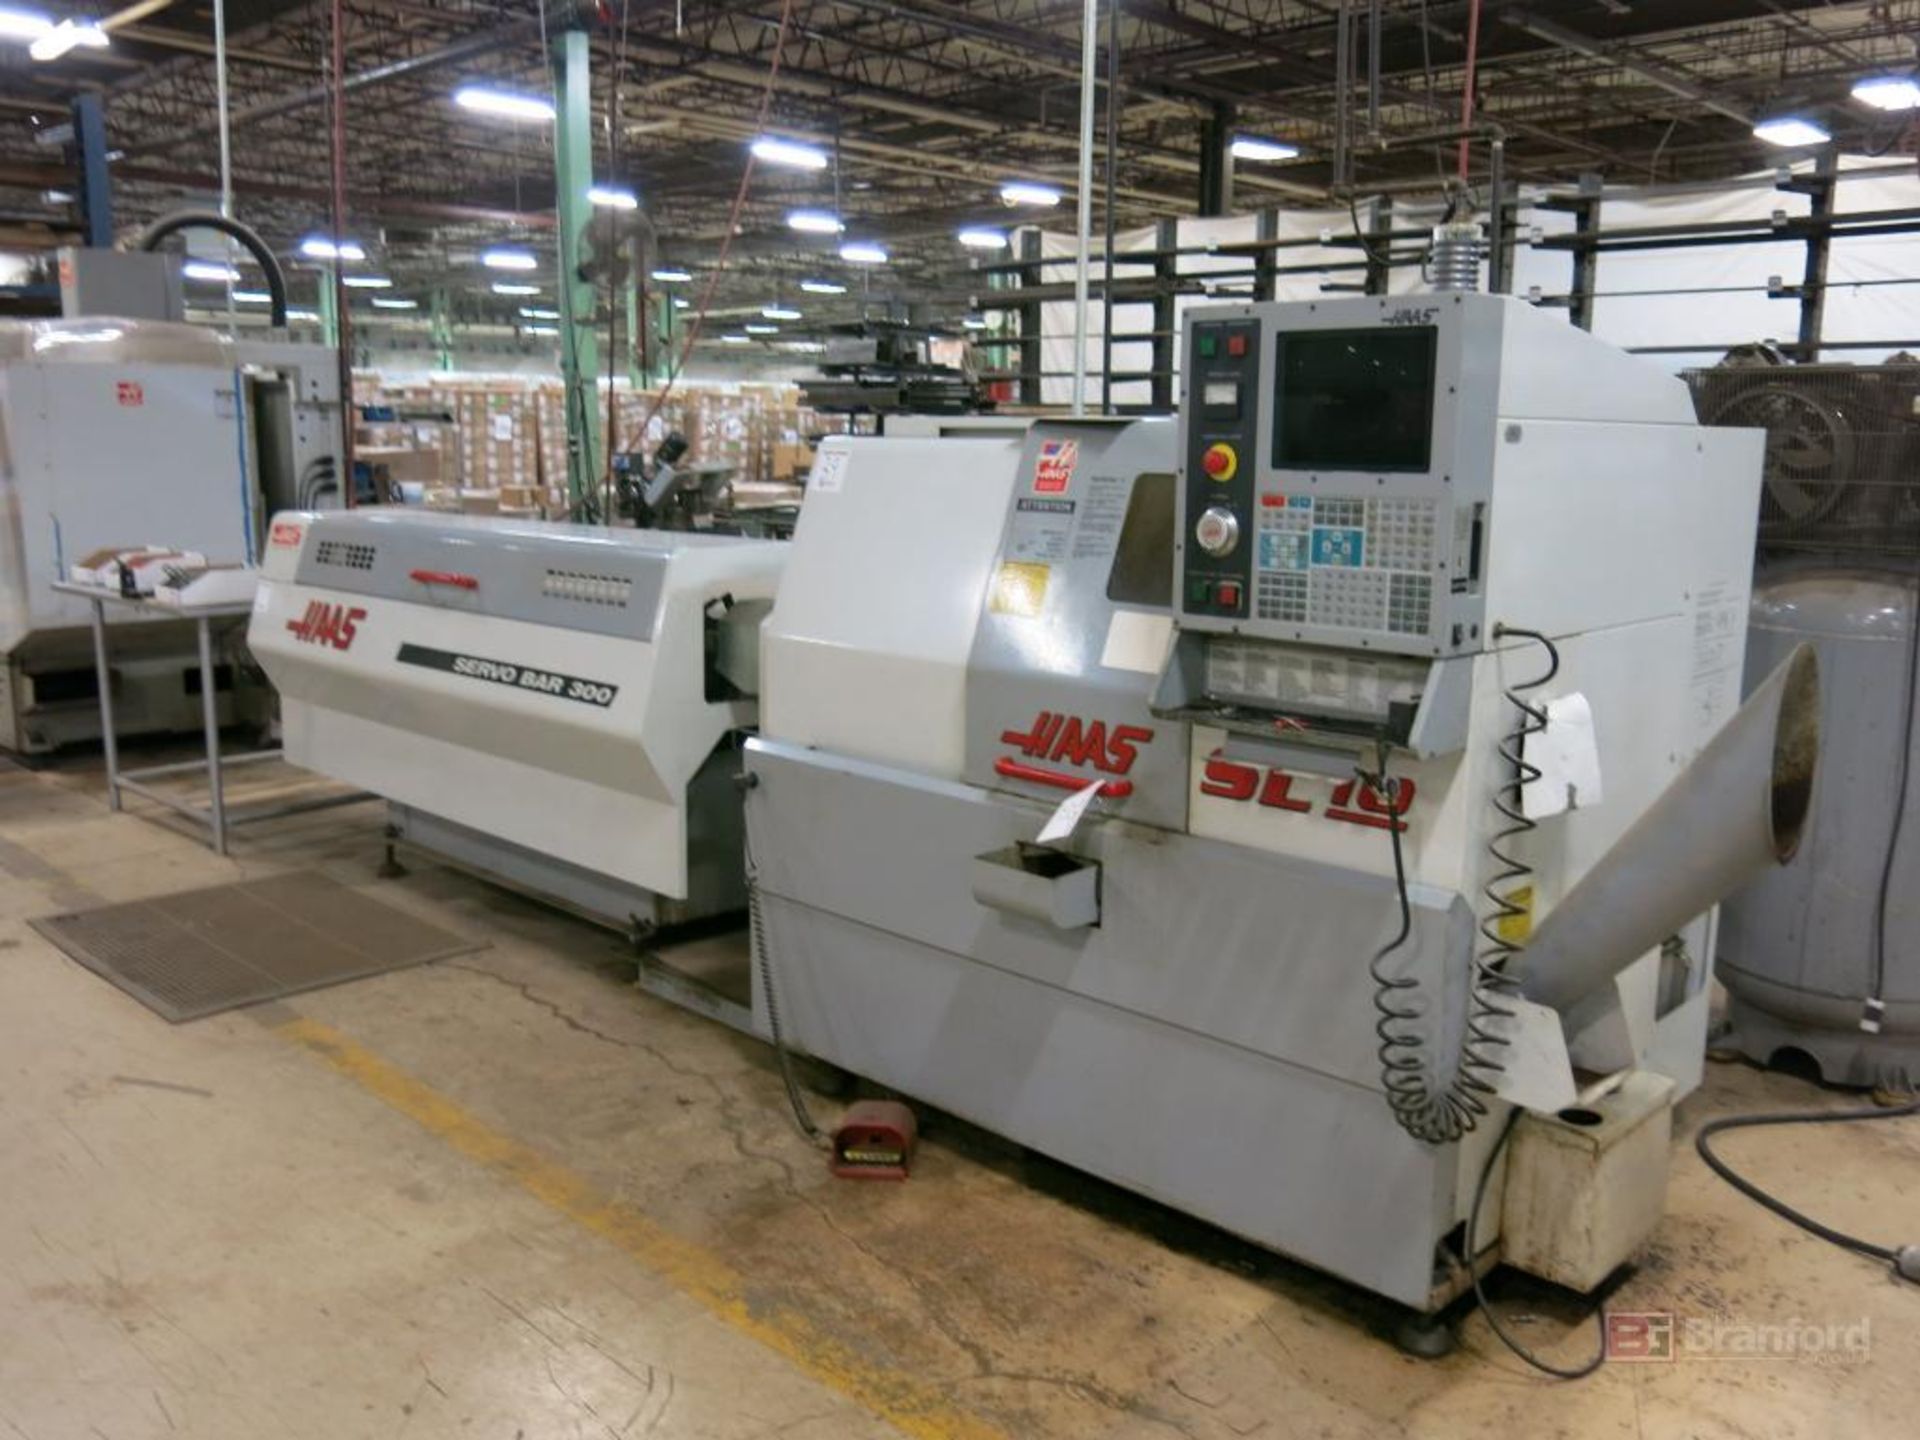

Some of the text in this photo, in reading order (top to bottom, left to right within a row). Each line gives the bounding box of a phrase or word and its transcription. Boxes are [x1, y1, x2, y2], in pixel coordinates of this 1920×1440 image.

[286, 599, 368, 651] HAAS
[452, 656, 613, 704] SERVO BAR 300
[1001, 710, 1154, 775] HAAS
